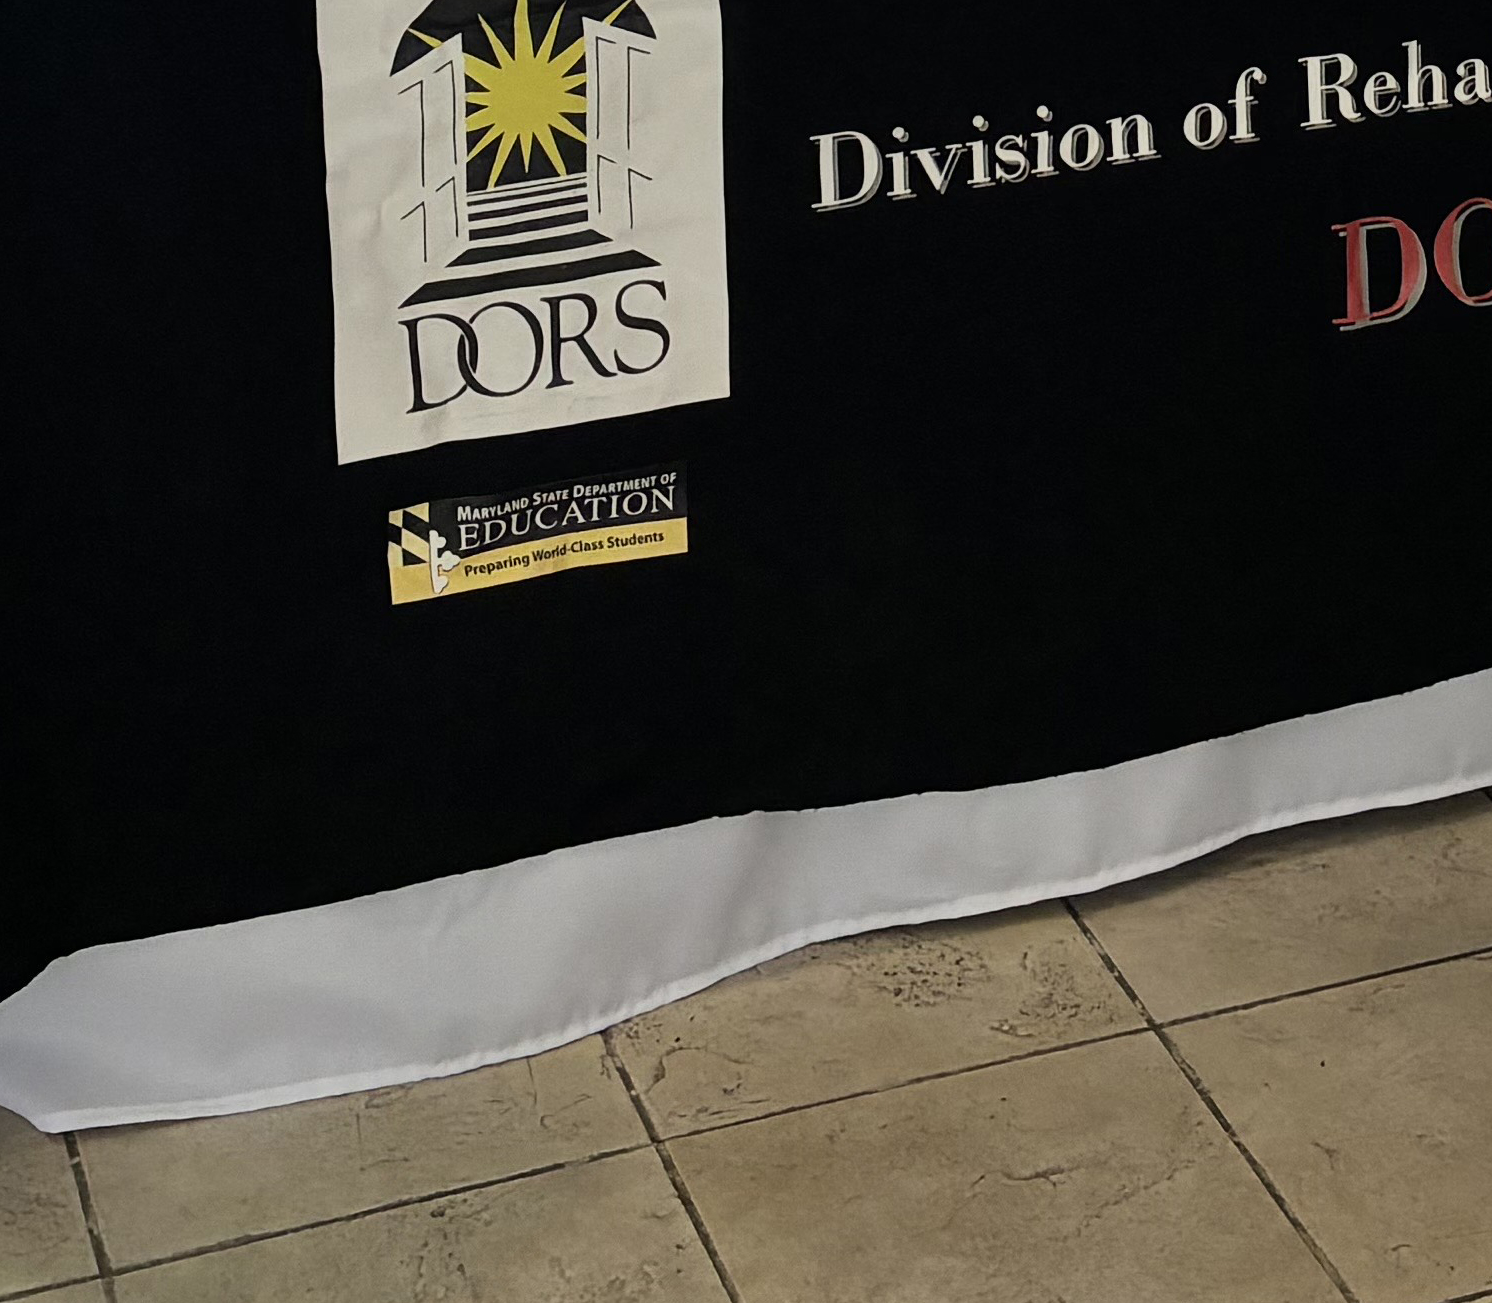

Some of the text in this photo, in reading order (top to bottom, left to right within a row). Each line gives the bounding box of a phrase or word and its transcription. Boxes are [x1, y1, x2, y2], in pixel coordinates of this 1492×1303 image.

[809, 103, 1161, 212] Division
[1182, 66, 1268, 148] of
[398, 280, 671, 415] DORS
[458, 472, 676, 521] MARYLAND STATE DEPARTMENT OF
[458, 485, 675, 552] EDUCATION
[464, 531, 664, 577] Preparing World-Class Students
